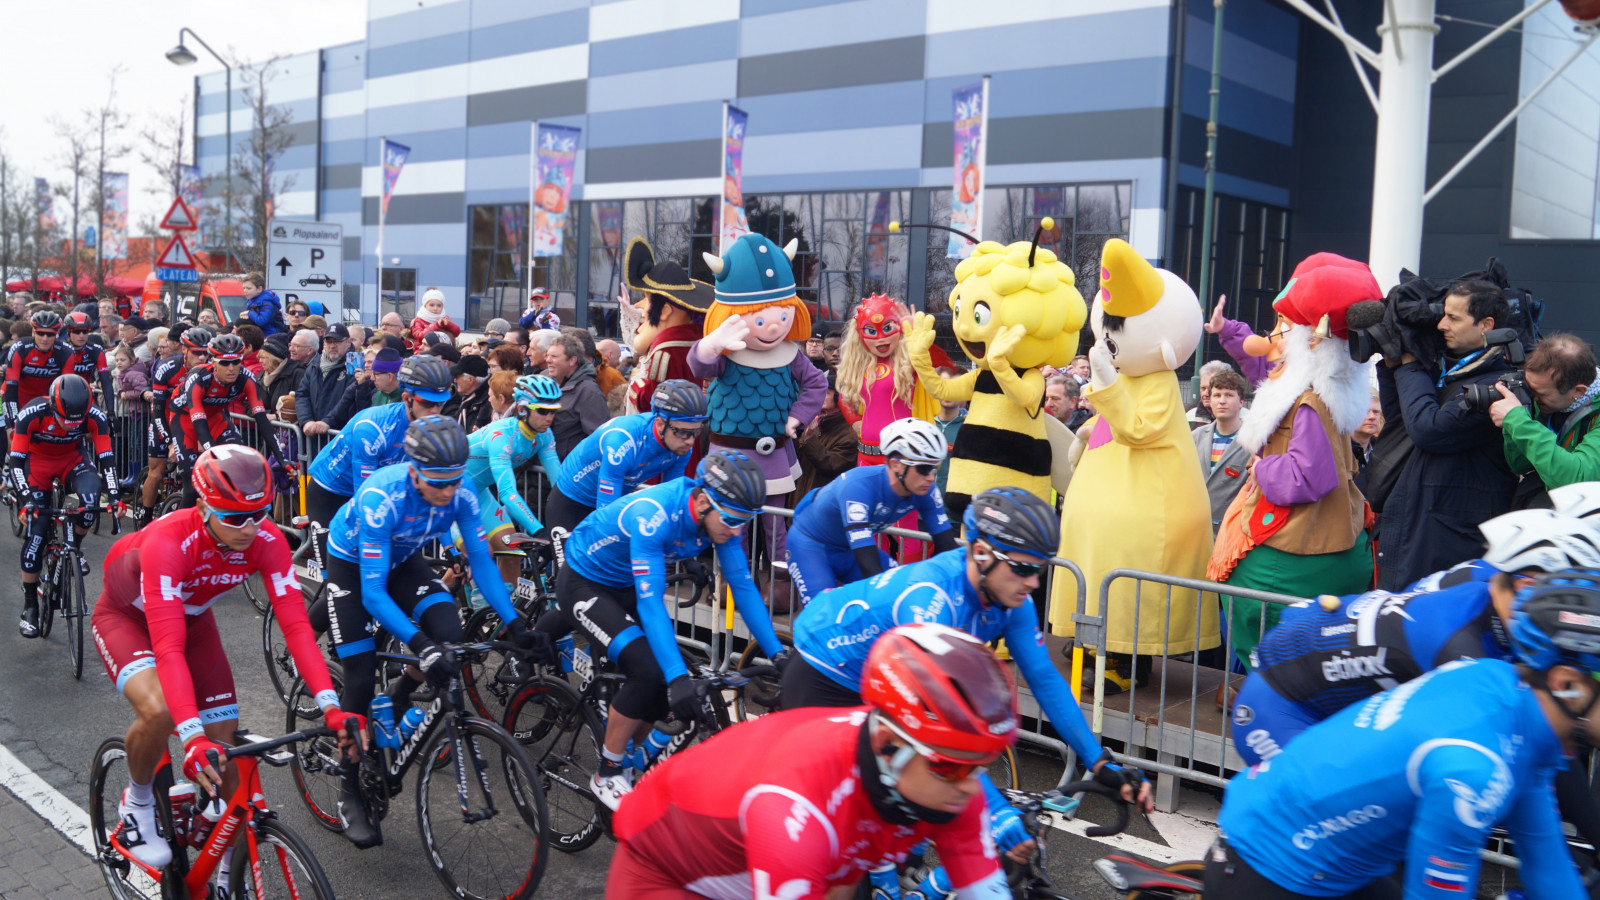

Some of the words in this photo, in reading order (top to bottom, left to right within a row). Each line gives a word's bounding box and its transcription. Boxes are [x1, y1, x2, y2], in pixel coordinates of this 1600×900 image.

[292, 227, 339, 241] Plopsaland
[310, 248, 325, 268] P
[156, 268, 199, 281] PLATEAU
[22, 366, 60, 375] BMC
[74, 363, 95, 371] MC
[155, 360, 176, 381] BMC
[184, 373, 199, 392] BM
[17, 403, 46, 422] BMC
[88, 406, 108, 422] MC
[154, 418, 169, 438] BMC
[9, 451, 27, 459] BMC
[99, 451, 114, 459] BMC
[13, 467, 30, 491] BMC
[103, 467, 117, 490] BMC
[519, 583, 531, 598] 222
[327, 597, 344, 644] GAZPROM
[390, 697, 442, 776] COLNAGO
[208, 814, 240, 857] CANYON
